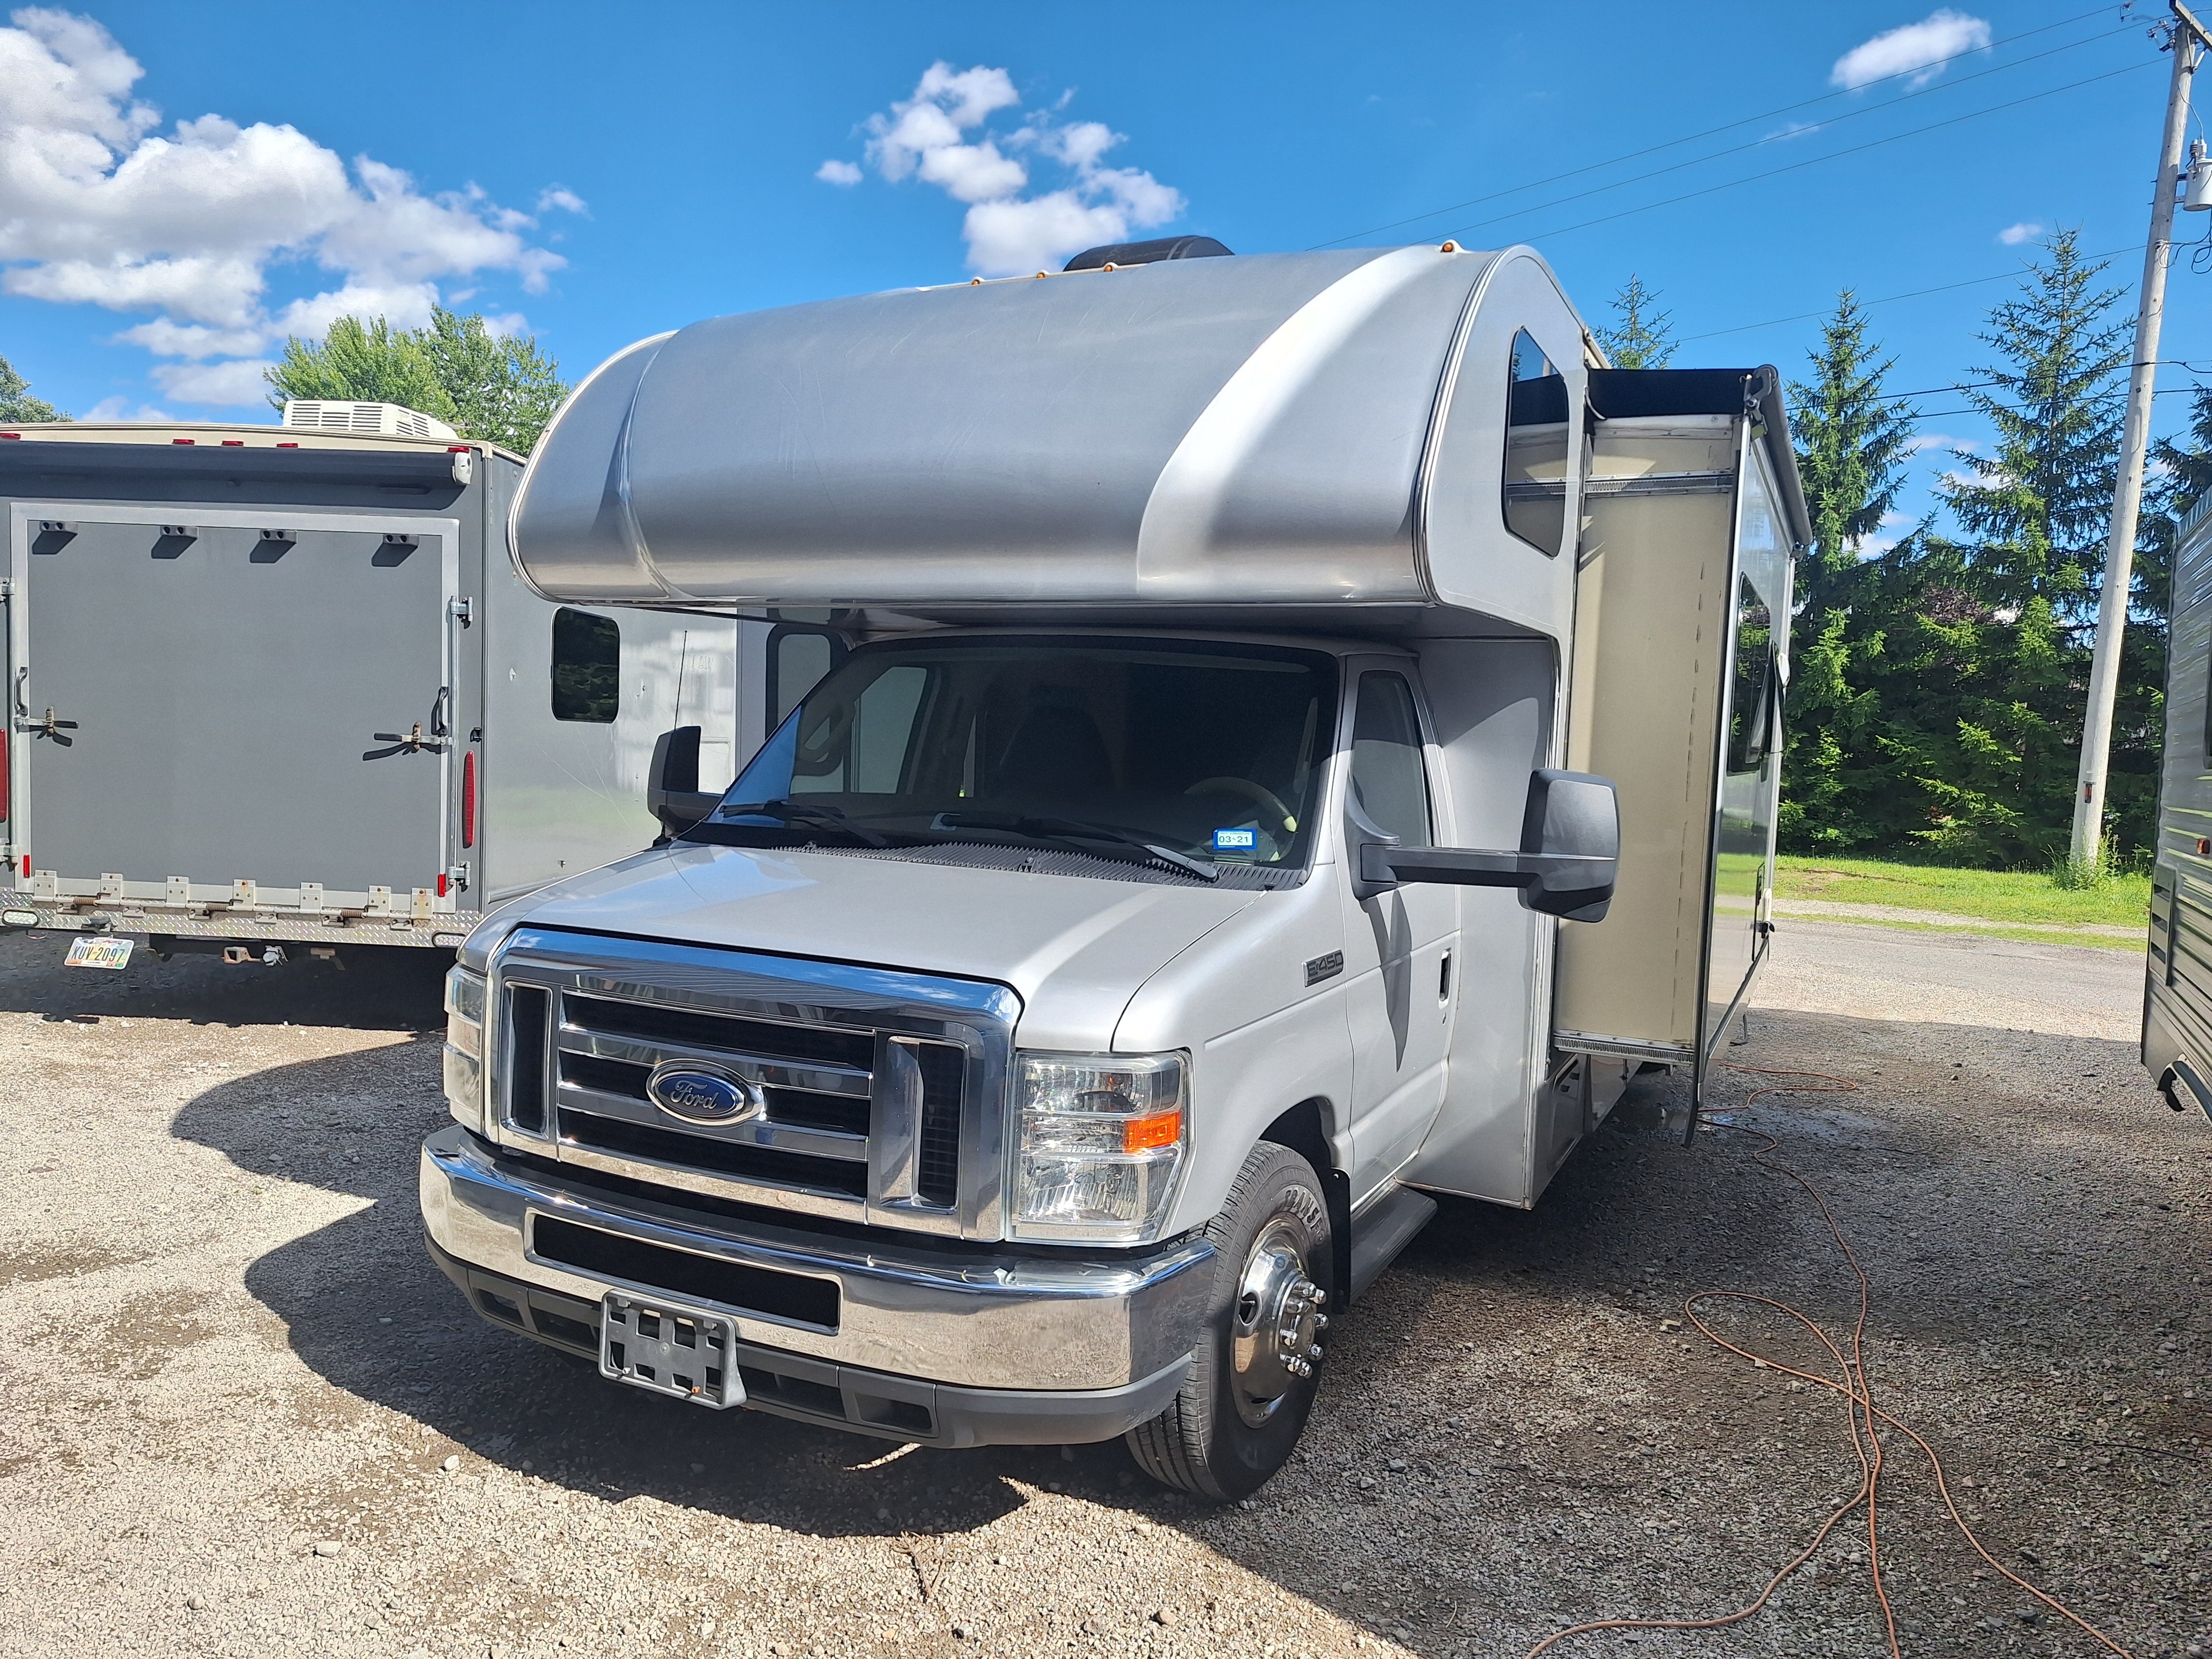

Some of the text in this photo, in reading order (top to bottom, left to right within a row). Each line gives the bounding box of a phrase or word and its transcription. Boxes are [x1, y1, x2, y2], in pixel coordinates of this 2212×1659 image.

[72, 946, 125, 962] KUV 2097
[670, 1080, 719, 1109] Ford
